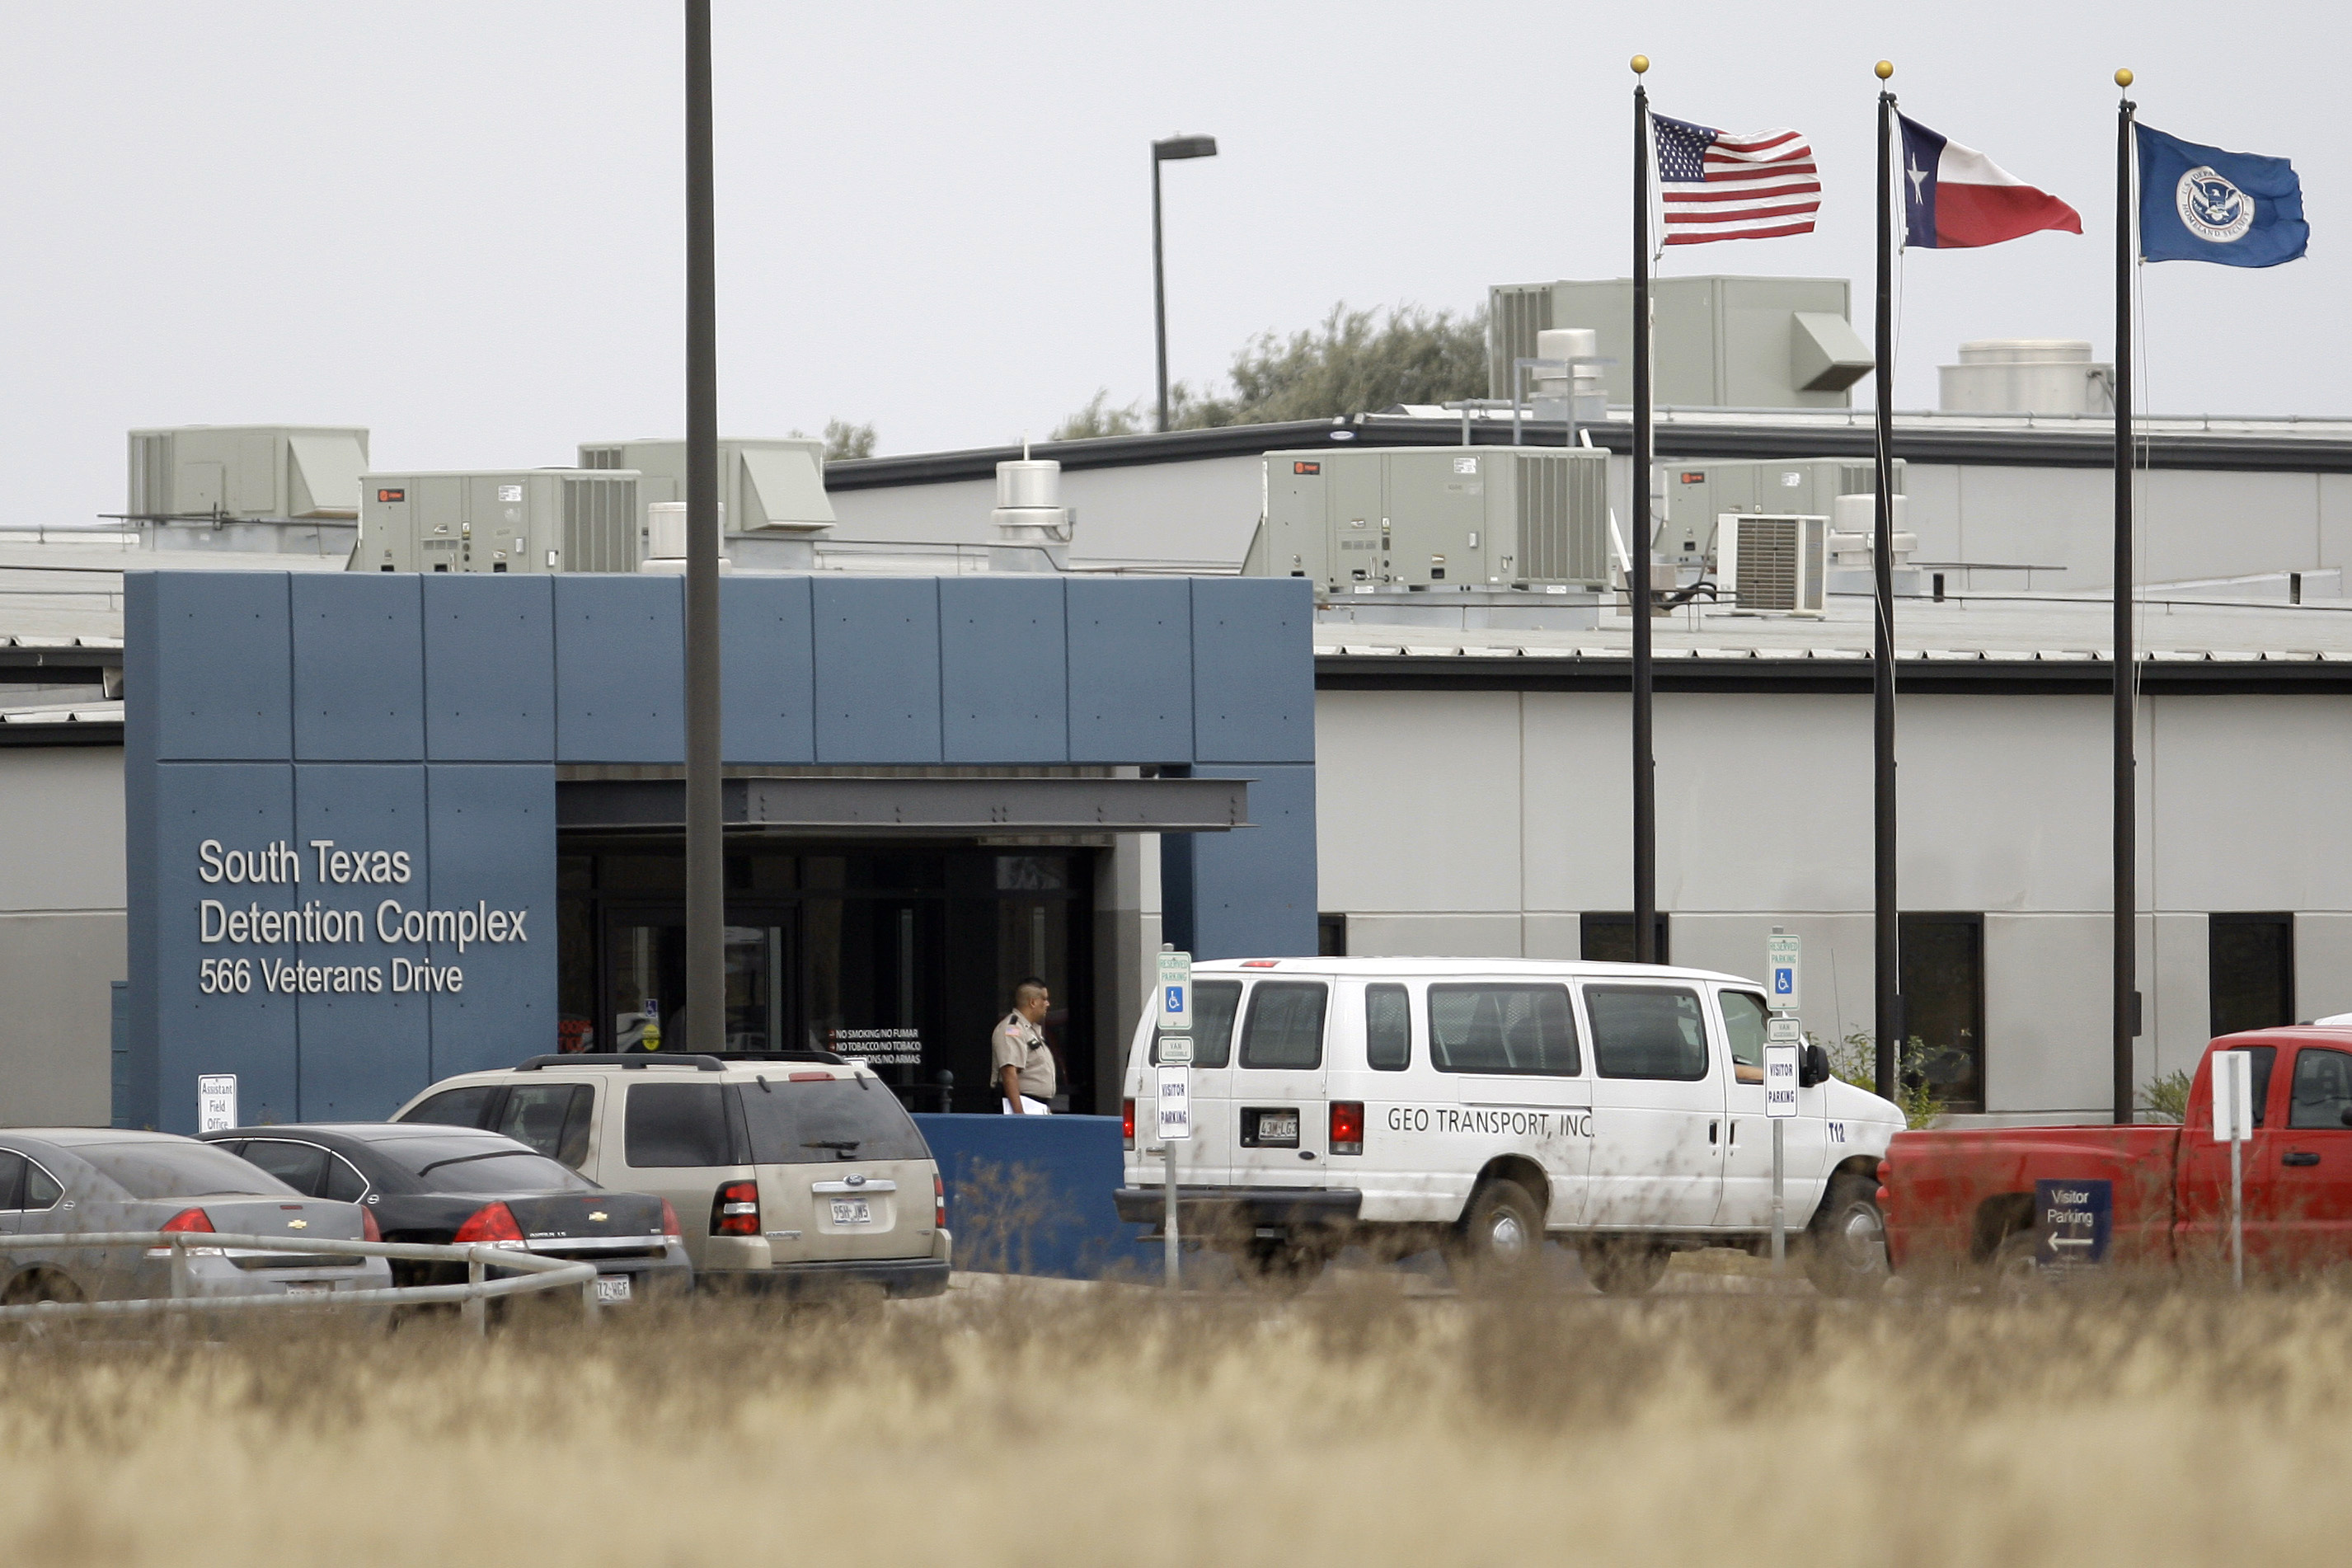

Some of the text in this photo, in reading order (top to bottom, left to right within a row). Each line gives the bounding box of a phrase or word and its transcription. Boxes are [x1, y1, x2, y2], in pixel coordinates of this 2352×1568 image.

[199, 839, 412, 884] South Texas
[200, 899, 528, 953] Detention Complex
[1772, 955, 1796, 964] PARKING
[200, 957, 464, 994] 566 Veterans Drive
[1162, 973, 1187, 982] PARKING
[835, 1030, 847, 1039] NO
[893, 1029, 918, 1038] FUMAR
[836, 1042, 847, 1051] NO
[893, 1041, 922, 1051] TOBACO
[895, 1054, 922, 1064] ARMAS
[1770, 1063, 1793, 1077] VISITOR
[202, 1082, 233, 1095] Assistant
[1162, 1083, 1185, 1096] VISITOR
[1768, 1090, 1795, 1103] PARKING
[209, 1099, 226, 1112] Field
[207, 1117, 228, 1130] Office
[1161, 1110, 1186, 1124] PARKING
[1387, 1107, 1595, 1139] GEO TRANSPORT, INC.
[1829, 1122, 1846, 1143] T12
[2051, 1190, 2090, 1204] Visitor
[2047, 1209, 2094, 1227] Parking
